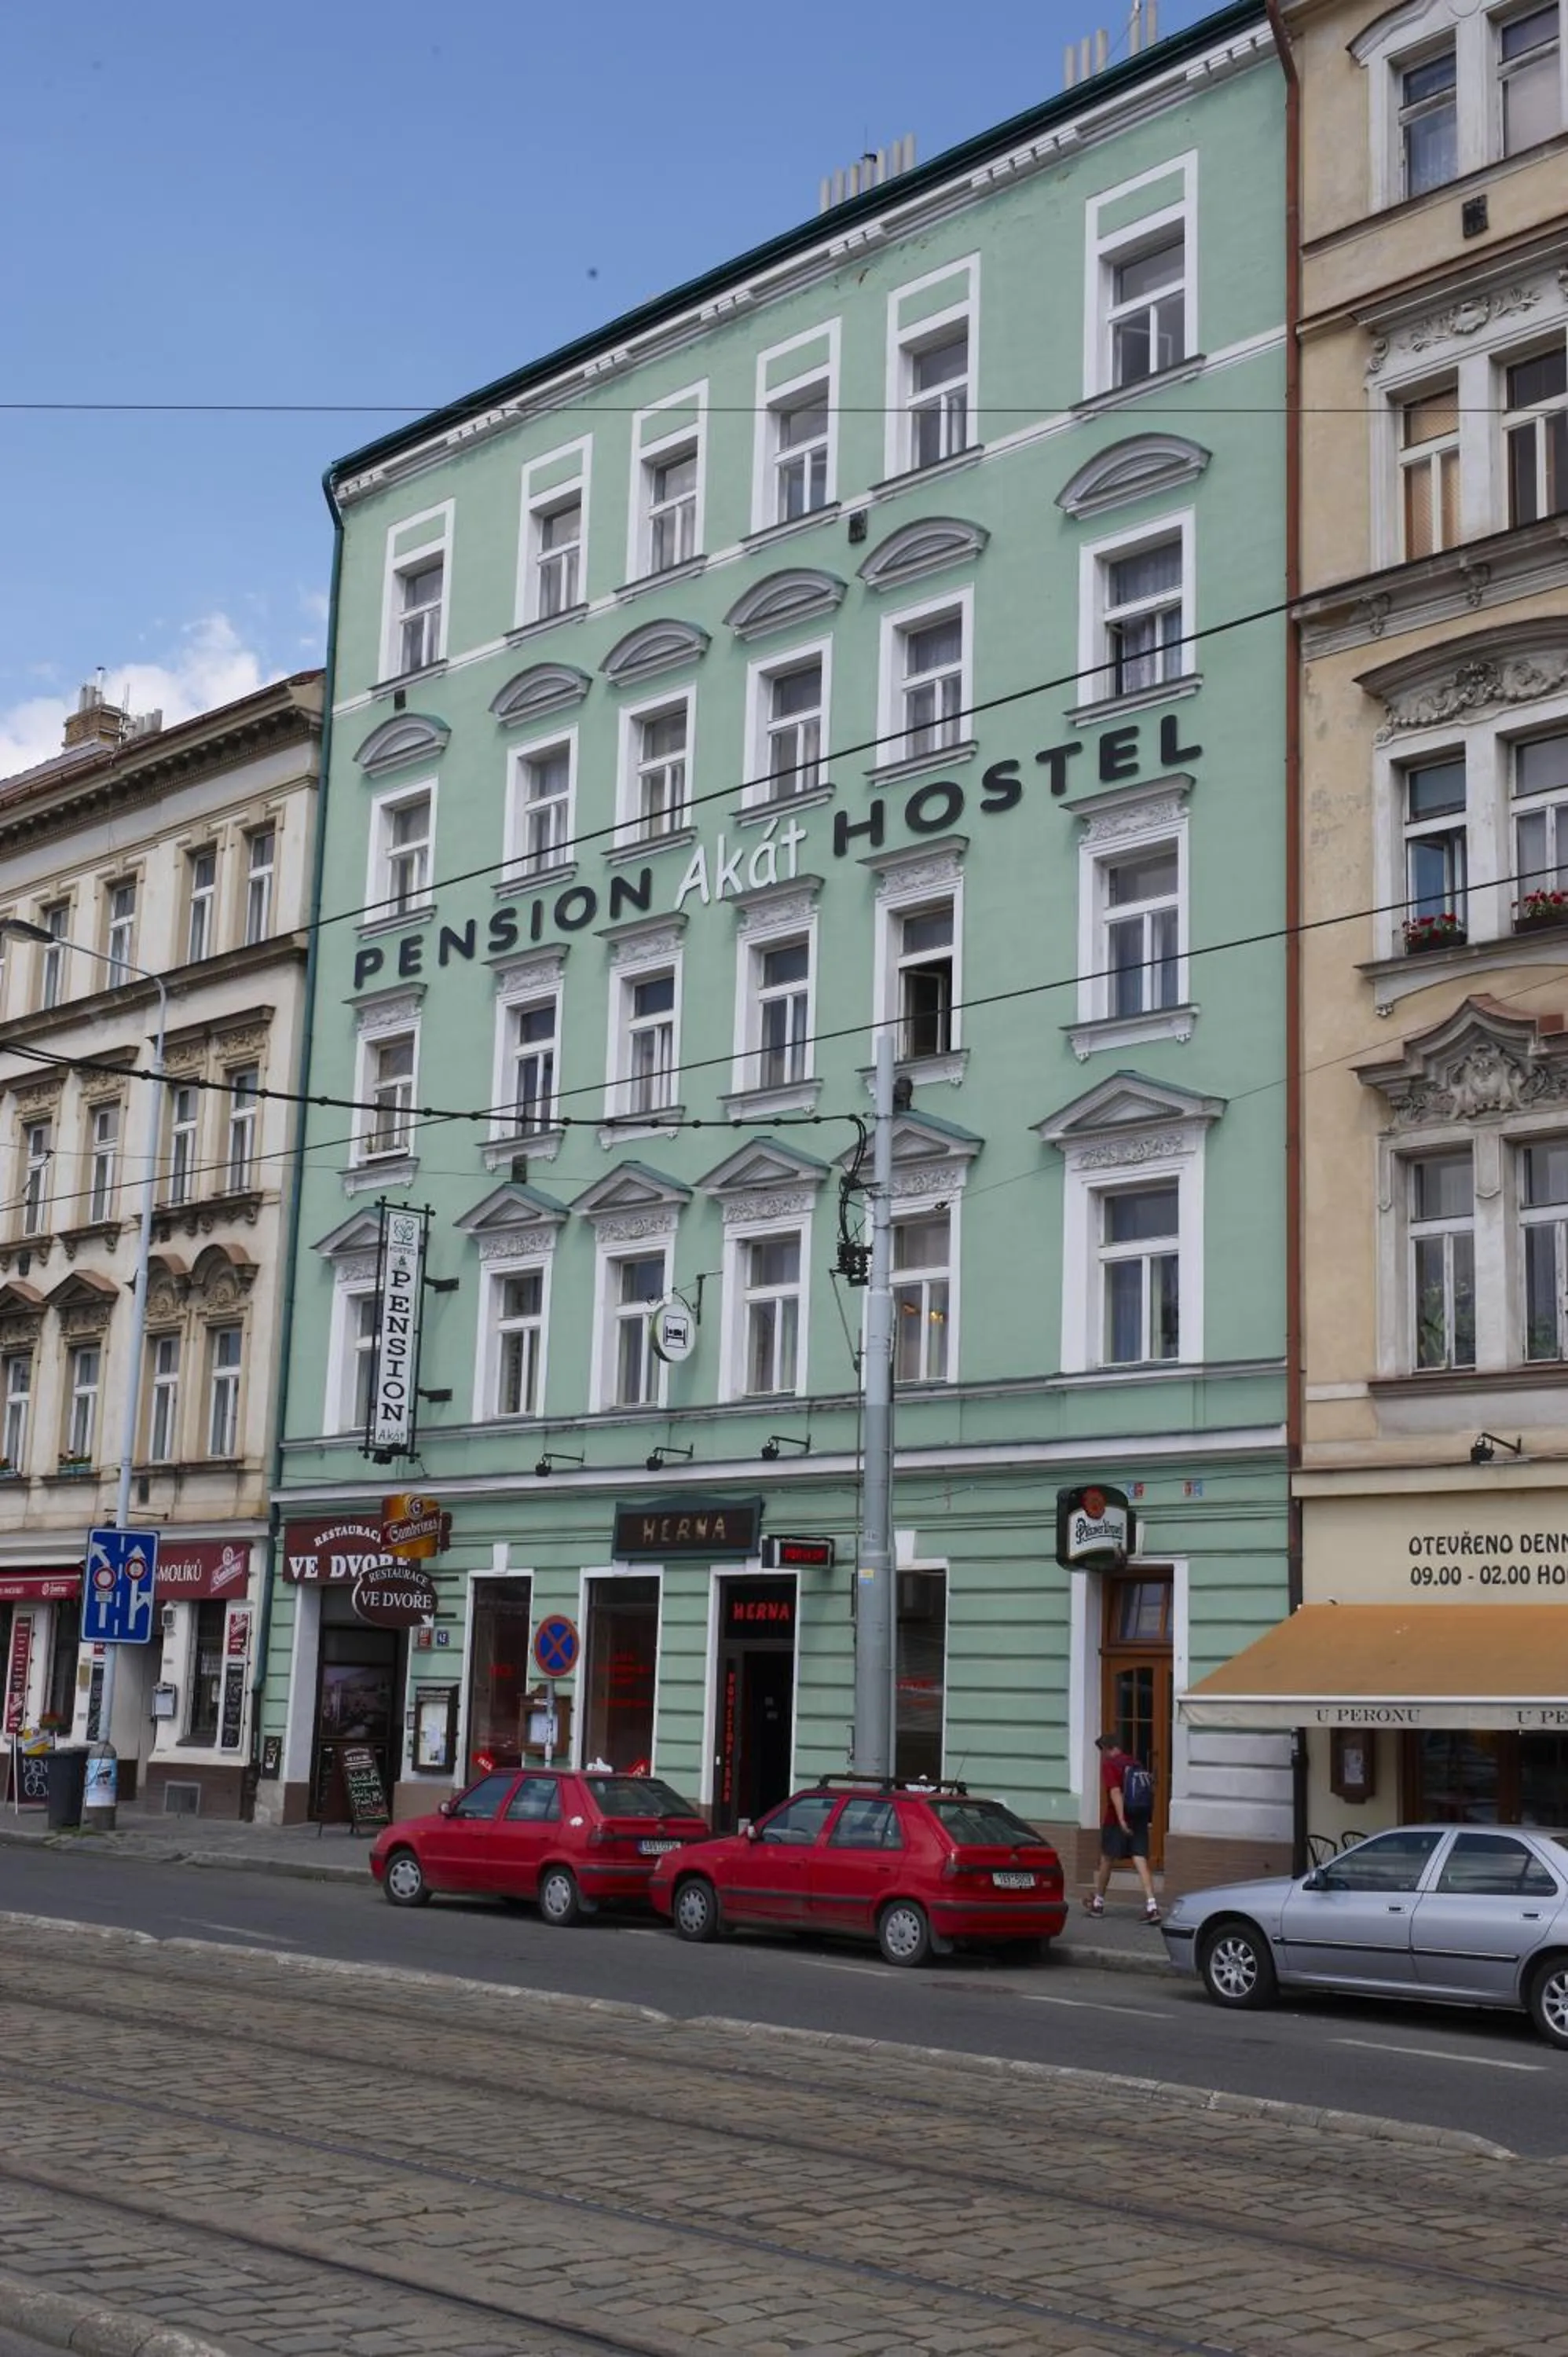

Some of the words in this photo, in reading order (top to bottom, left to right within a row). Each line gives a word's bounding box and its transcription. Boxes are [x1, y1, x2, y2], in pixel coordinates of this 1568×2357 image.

[354, 867, 653, 990] PENSION
[675, 817, 808, 910] Akát
[833, 714, 1203, 857] HOSTEL
[381, 1270, 412, 1421] PENSION
[643, 1515, 726, 1543] HERNA
[1409, 1530, 1513, 1556] OTEVŘENO
[156, 1559, 202, 1582] MOLÍKŮ
[288, 1556, 318, 1578] VE
[330, 1553, 410, 1578] DVO
[1410, 1566, 1462, 1585] 09.00
[1480, 1565, 1530, 1585] 02.00
[1537, 1565, 1568, 1585] HO
[368, 1567, 428, 1588] RESTAURACE
[361, 1590, 380, 1607] VE
[383, 1589, 433, 1610] DVOŘE
[734, 1601, 789, 1621] HERNA
[1315, 1709, 1329, 1723] U
[1337, 1709, 1420, 1723] PERONU
[1517, 1710, 1532, 1724] U
[23, 1758, 49, 1776] MEN
